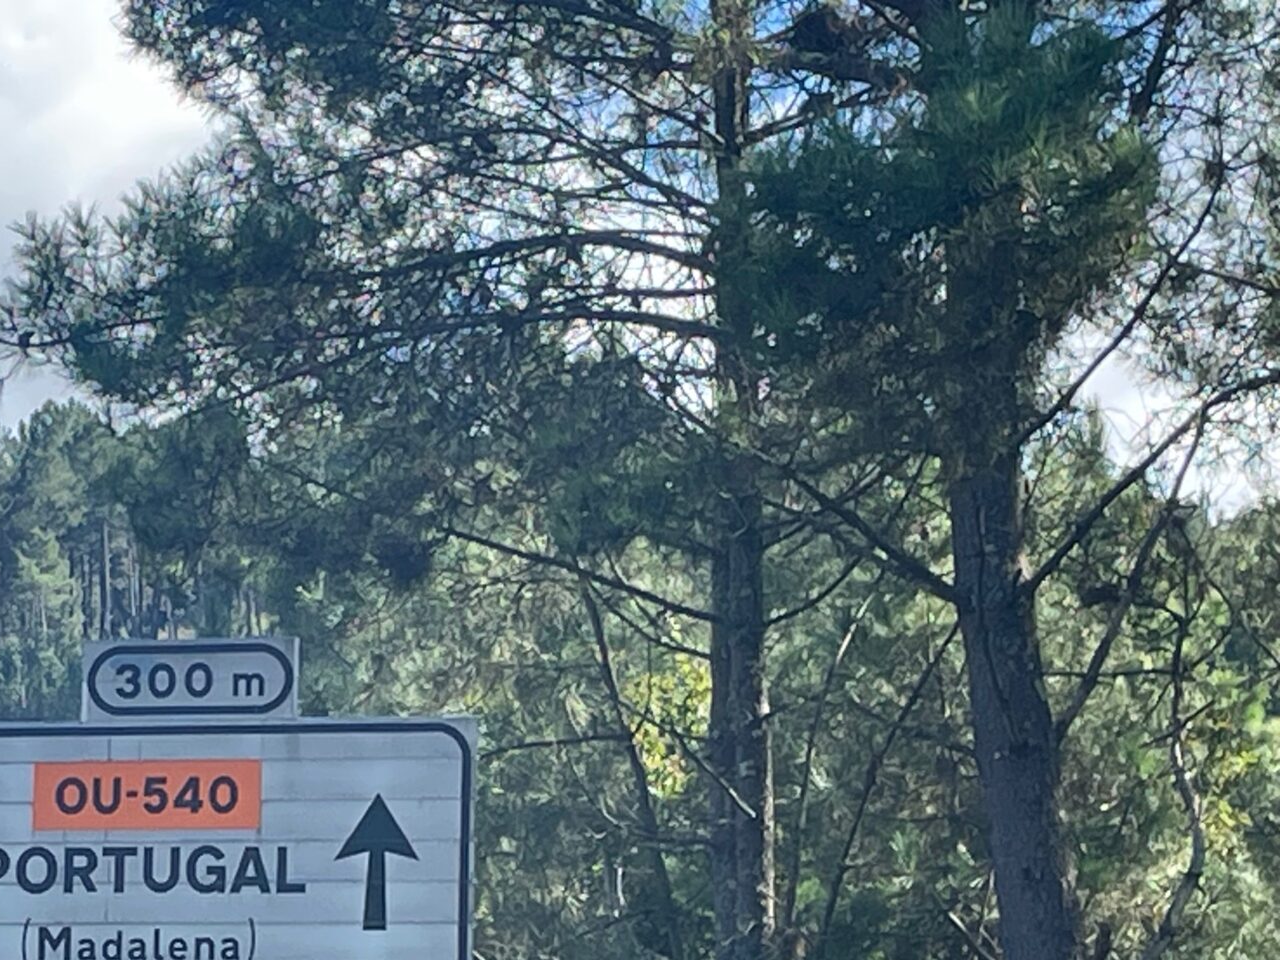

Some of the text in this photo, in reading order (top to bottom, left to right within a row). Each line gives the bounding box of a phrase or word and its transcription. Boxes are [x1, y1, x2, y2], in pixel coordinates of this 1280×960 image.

[115, 662, 265, 700] 300 m
[55, 775, 239, 815] OU-540
